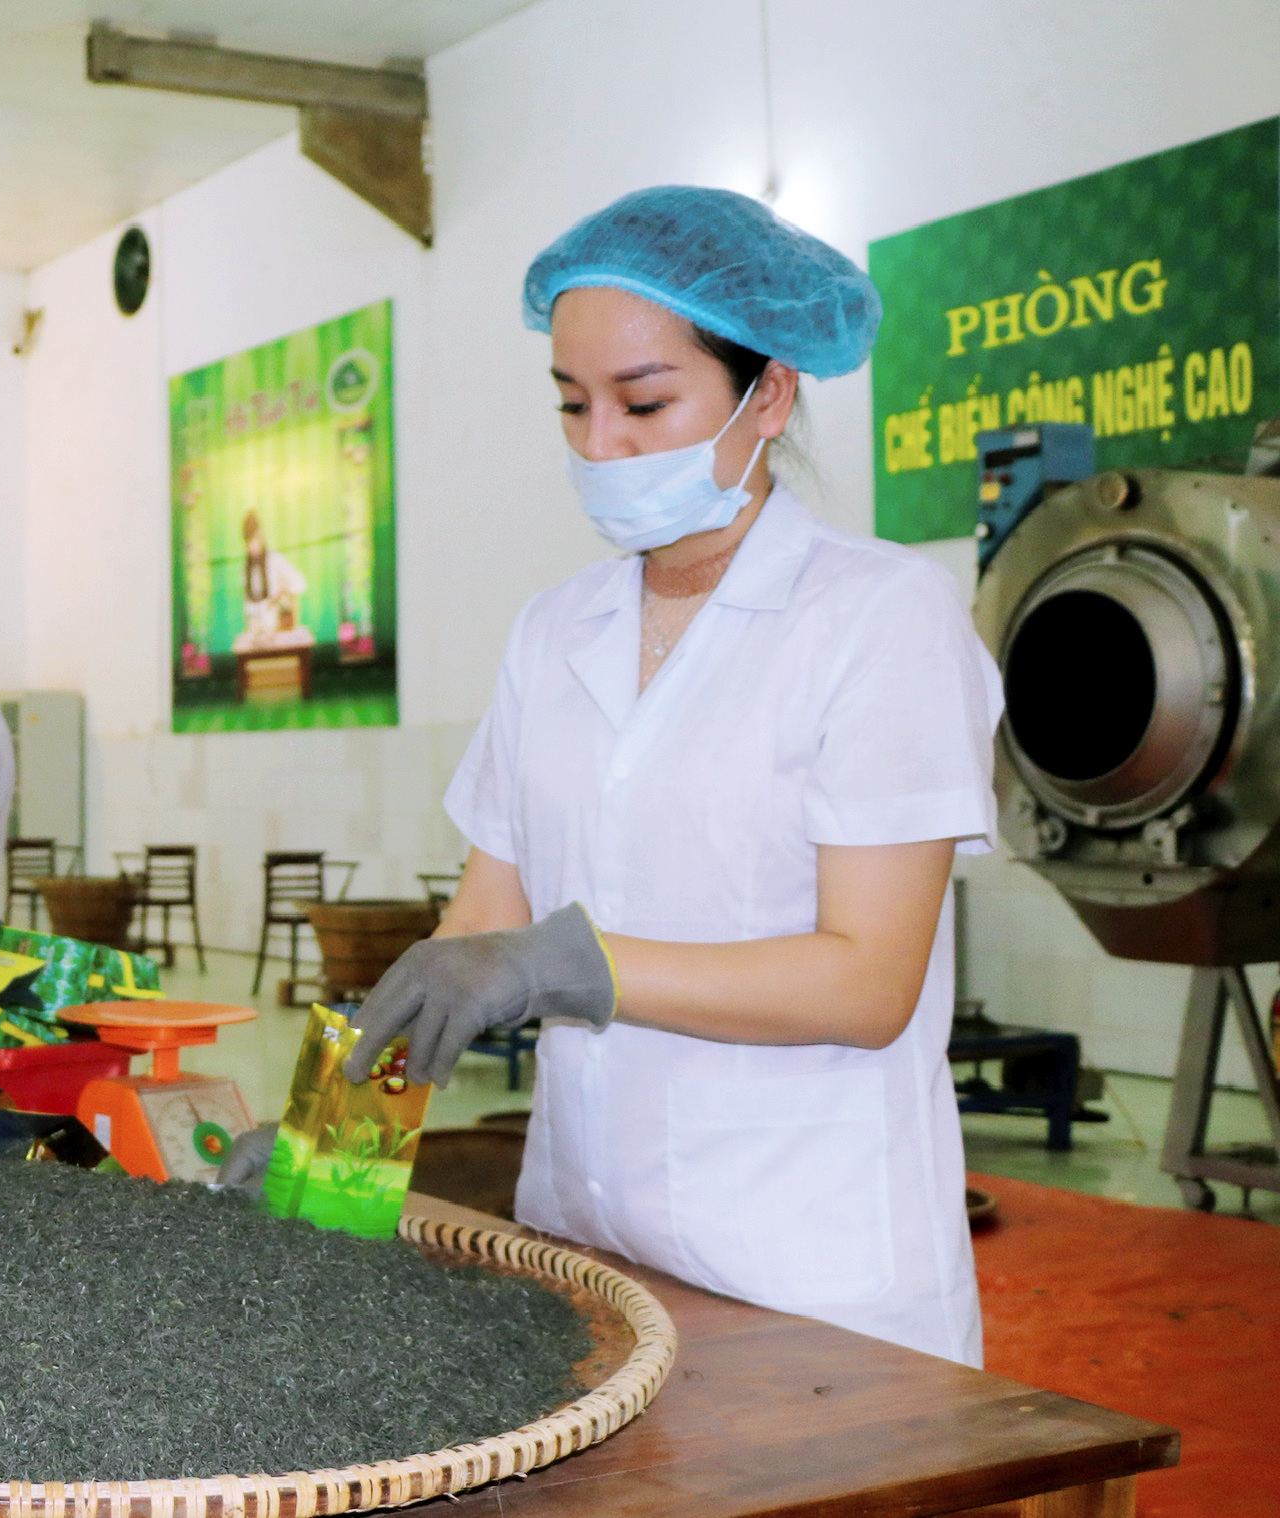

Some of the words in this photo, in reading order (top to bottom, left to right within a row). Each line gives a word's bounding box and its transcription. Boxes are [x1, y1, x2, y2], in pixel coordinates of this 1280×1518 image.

[946, 259, 1168, 356] PHÒNG
[885, 384, 933, 475] CHẾ
[938, 373, 1001, 465] BIẾN
[1092, 344, 1174, 442] NGHỆ
[1184, 342, 1253, 422] CAO
